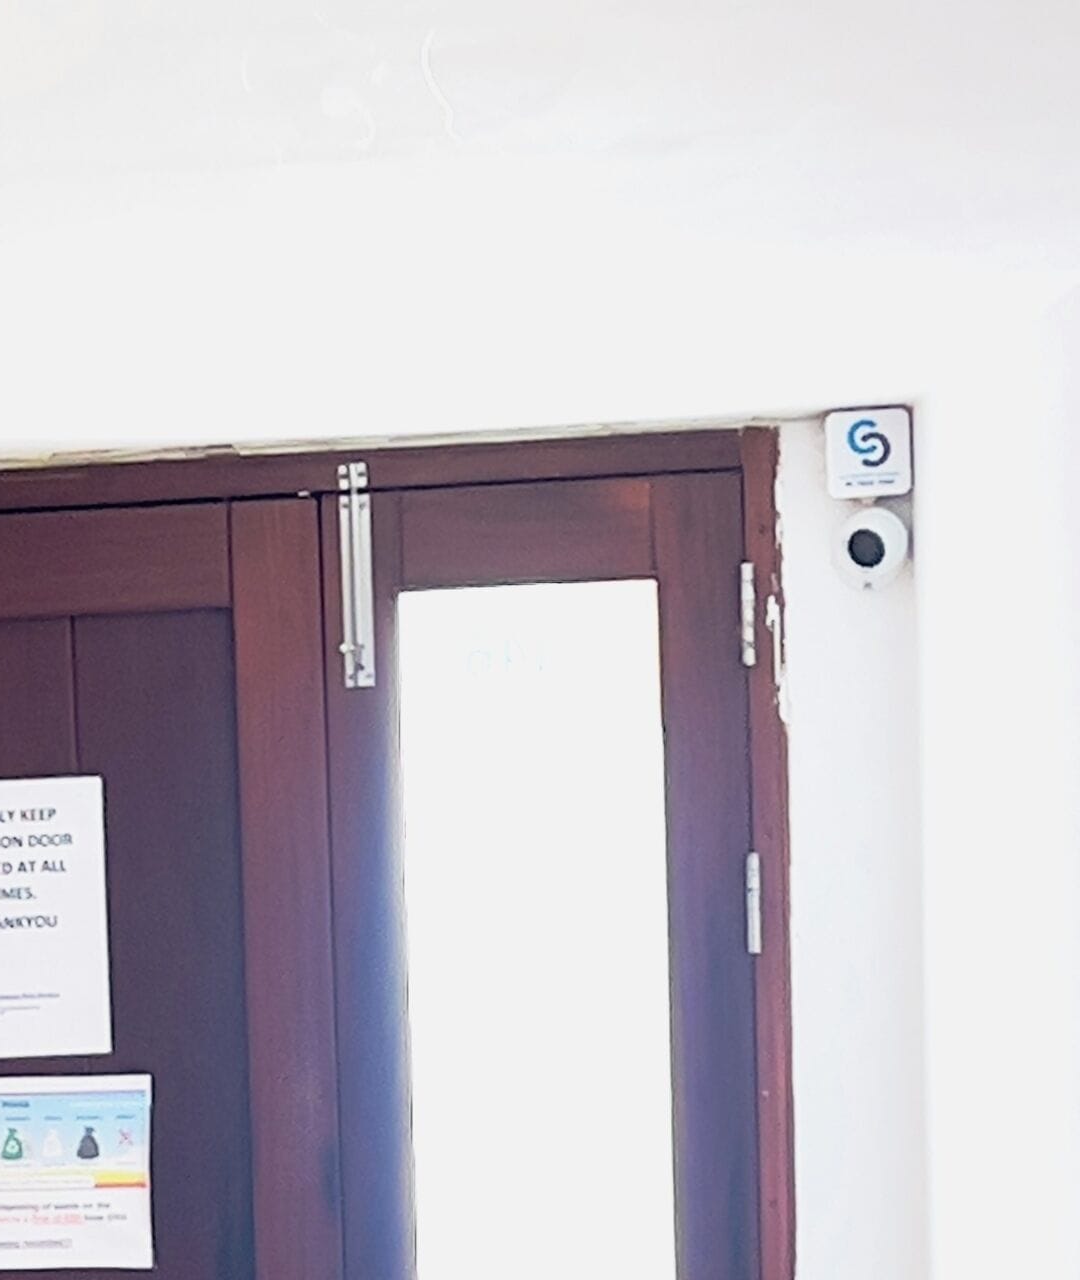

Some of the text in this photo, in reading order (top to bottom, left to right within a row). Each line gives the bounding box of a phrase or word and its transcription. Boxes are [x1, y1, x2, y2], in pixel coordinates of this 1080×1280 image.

[20, 807, 56, 821] KEEP
[27, 832, 73, 848] DOOR
[17, 860, 37, 873] AT
[41, 859, 67, 873] ALL
